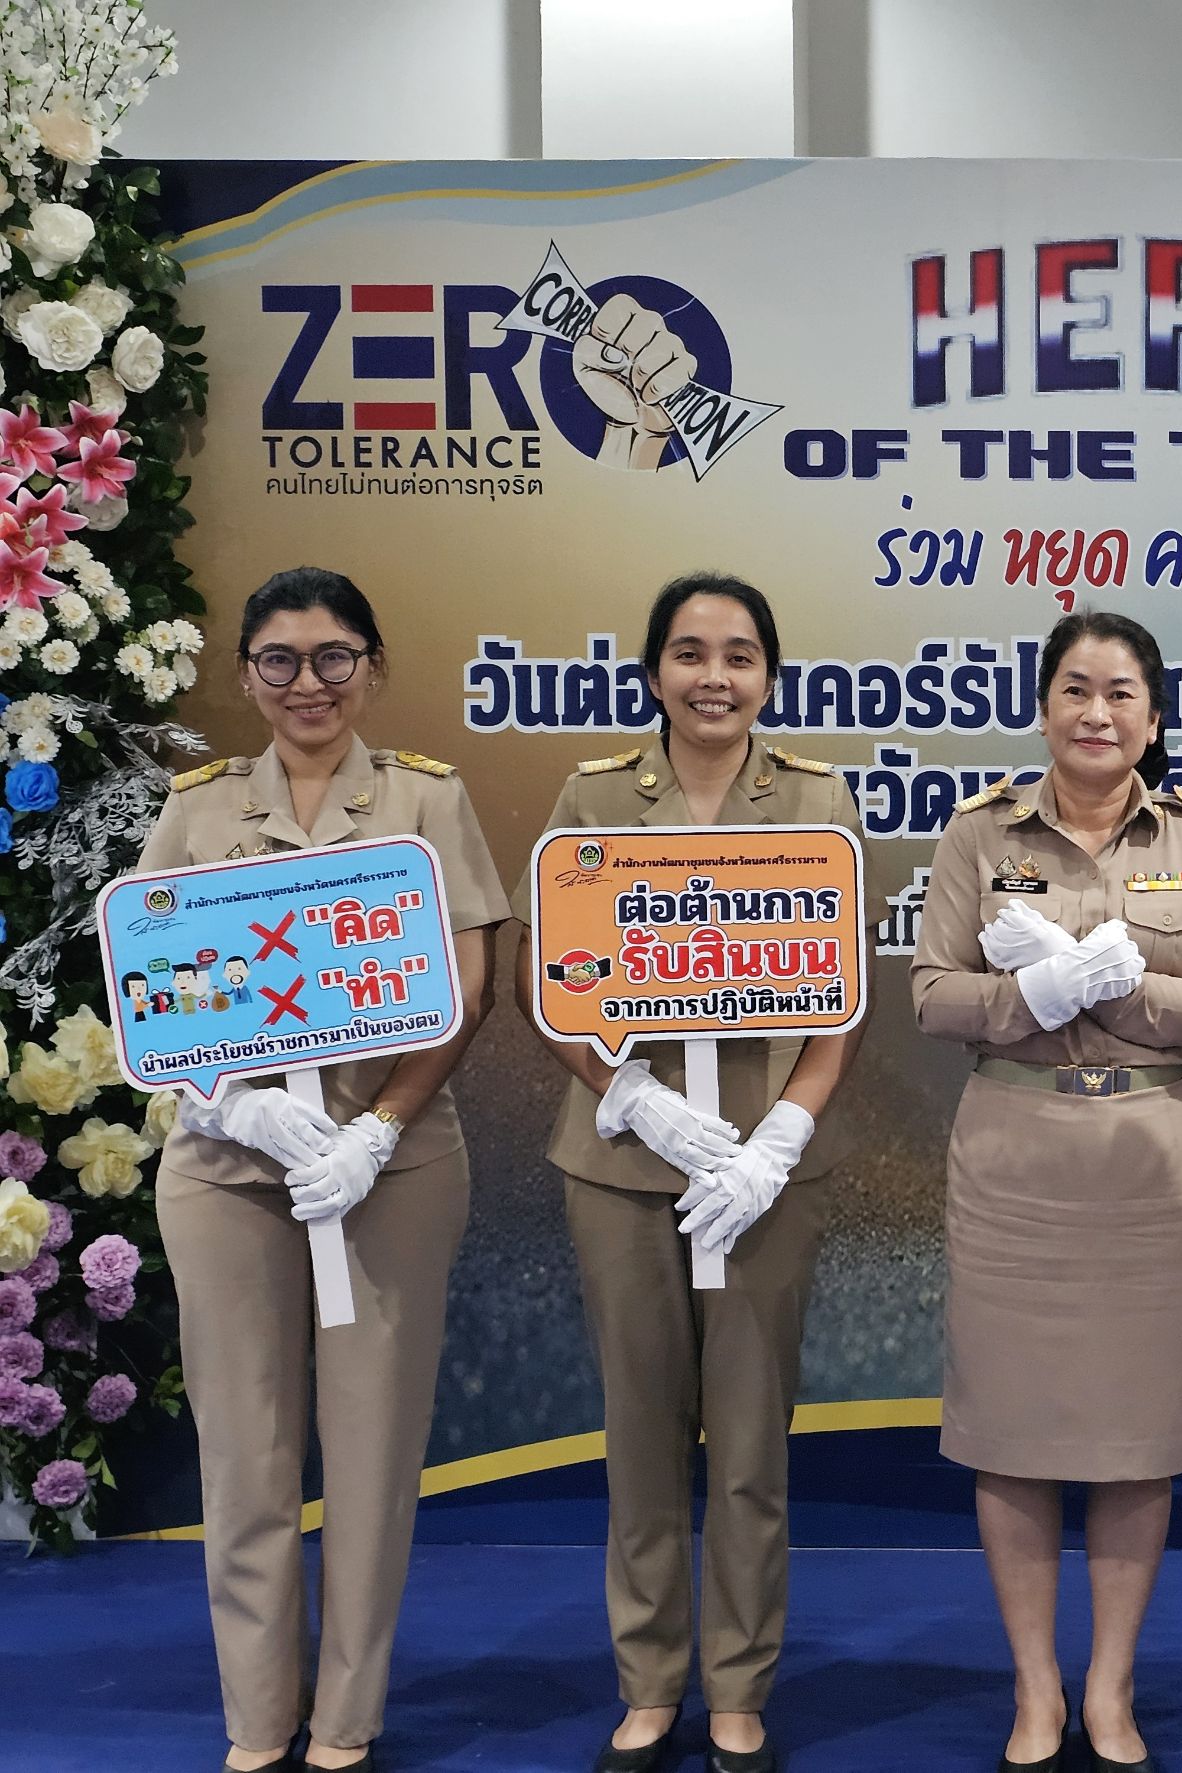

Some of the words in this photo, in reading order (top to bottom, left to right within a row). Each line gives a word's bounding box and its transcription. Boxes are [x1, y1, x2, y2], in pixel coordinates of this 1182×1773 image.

[262, 436, 541, 469] TOLERANCE
[784, 430, 908, 480] OF
[942, 431, 1136, 481] THE
[266, 472, 544, 502] คนไทยไม่ทนต่อการทุจริต
[875, 495, 984, 588] ร่วม
[1004, 529, 1130, 612] หยุด
[618, 879, 839, 924] ต่อต้านการ
[621, 927, 840, 981] รับสินบน
[603, 980, 843, 1021] จากการปฏิบัติหน้าที่
[142, 1010, 440, 1074] นำผลประโยชน์ราชการมาเป็นของตน
